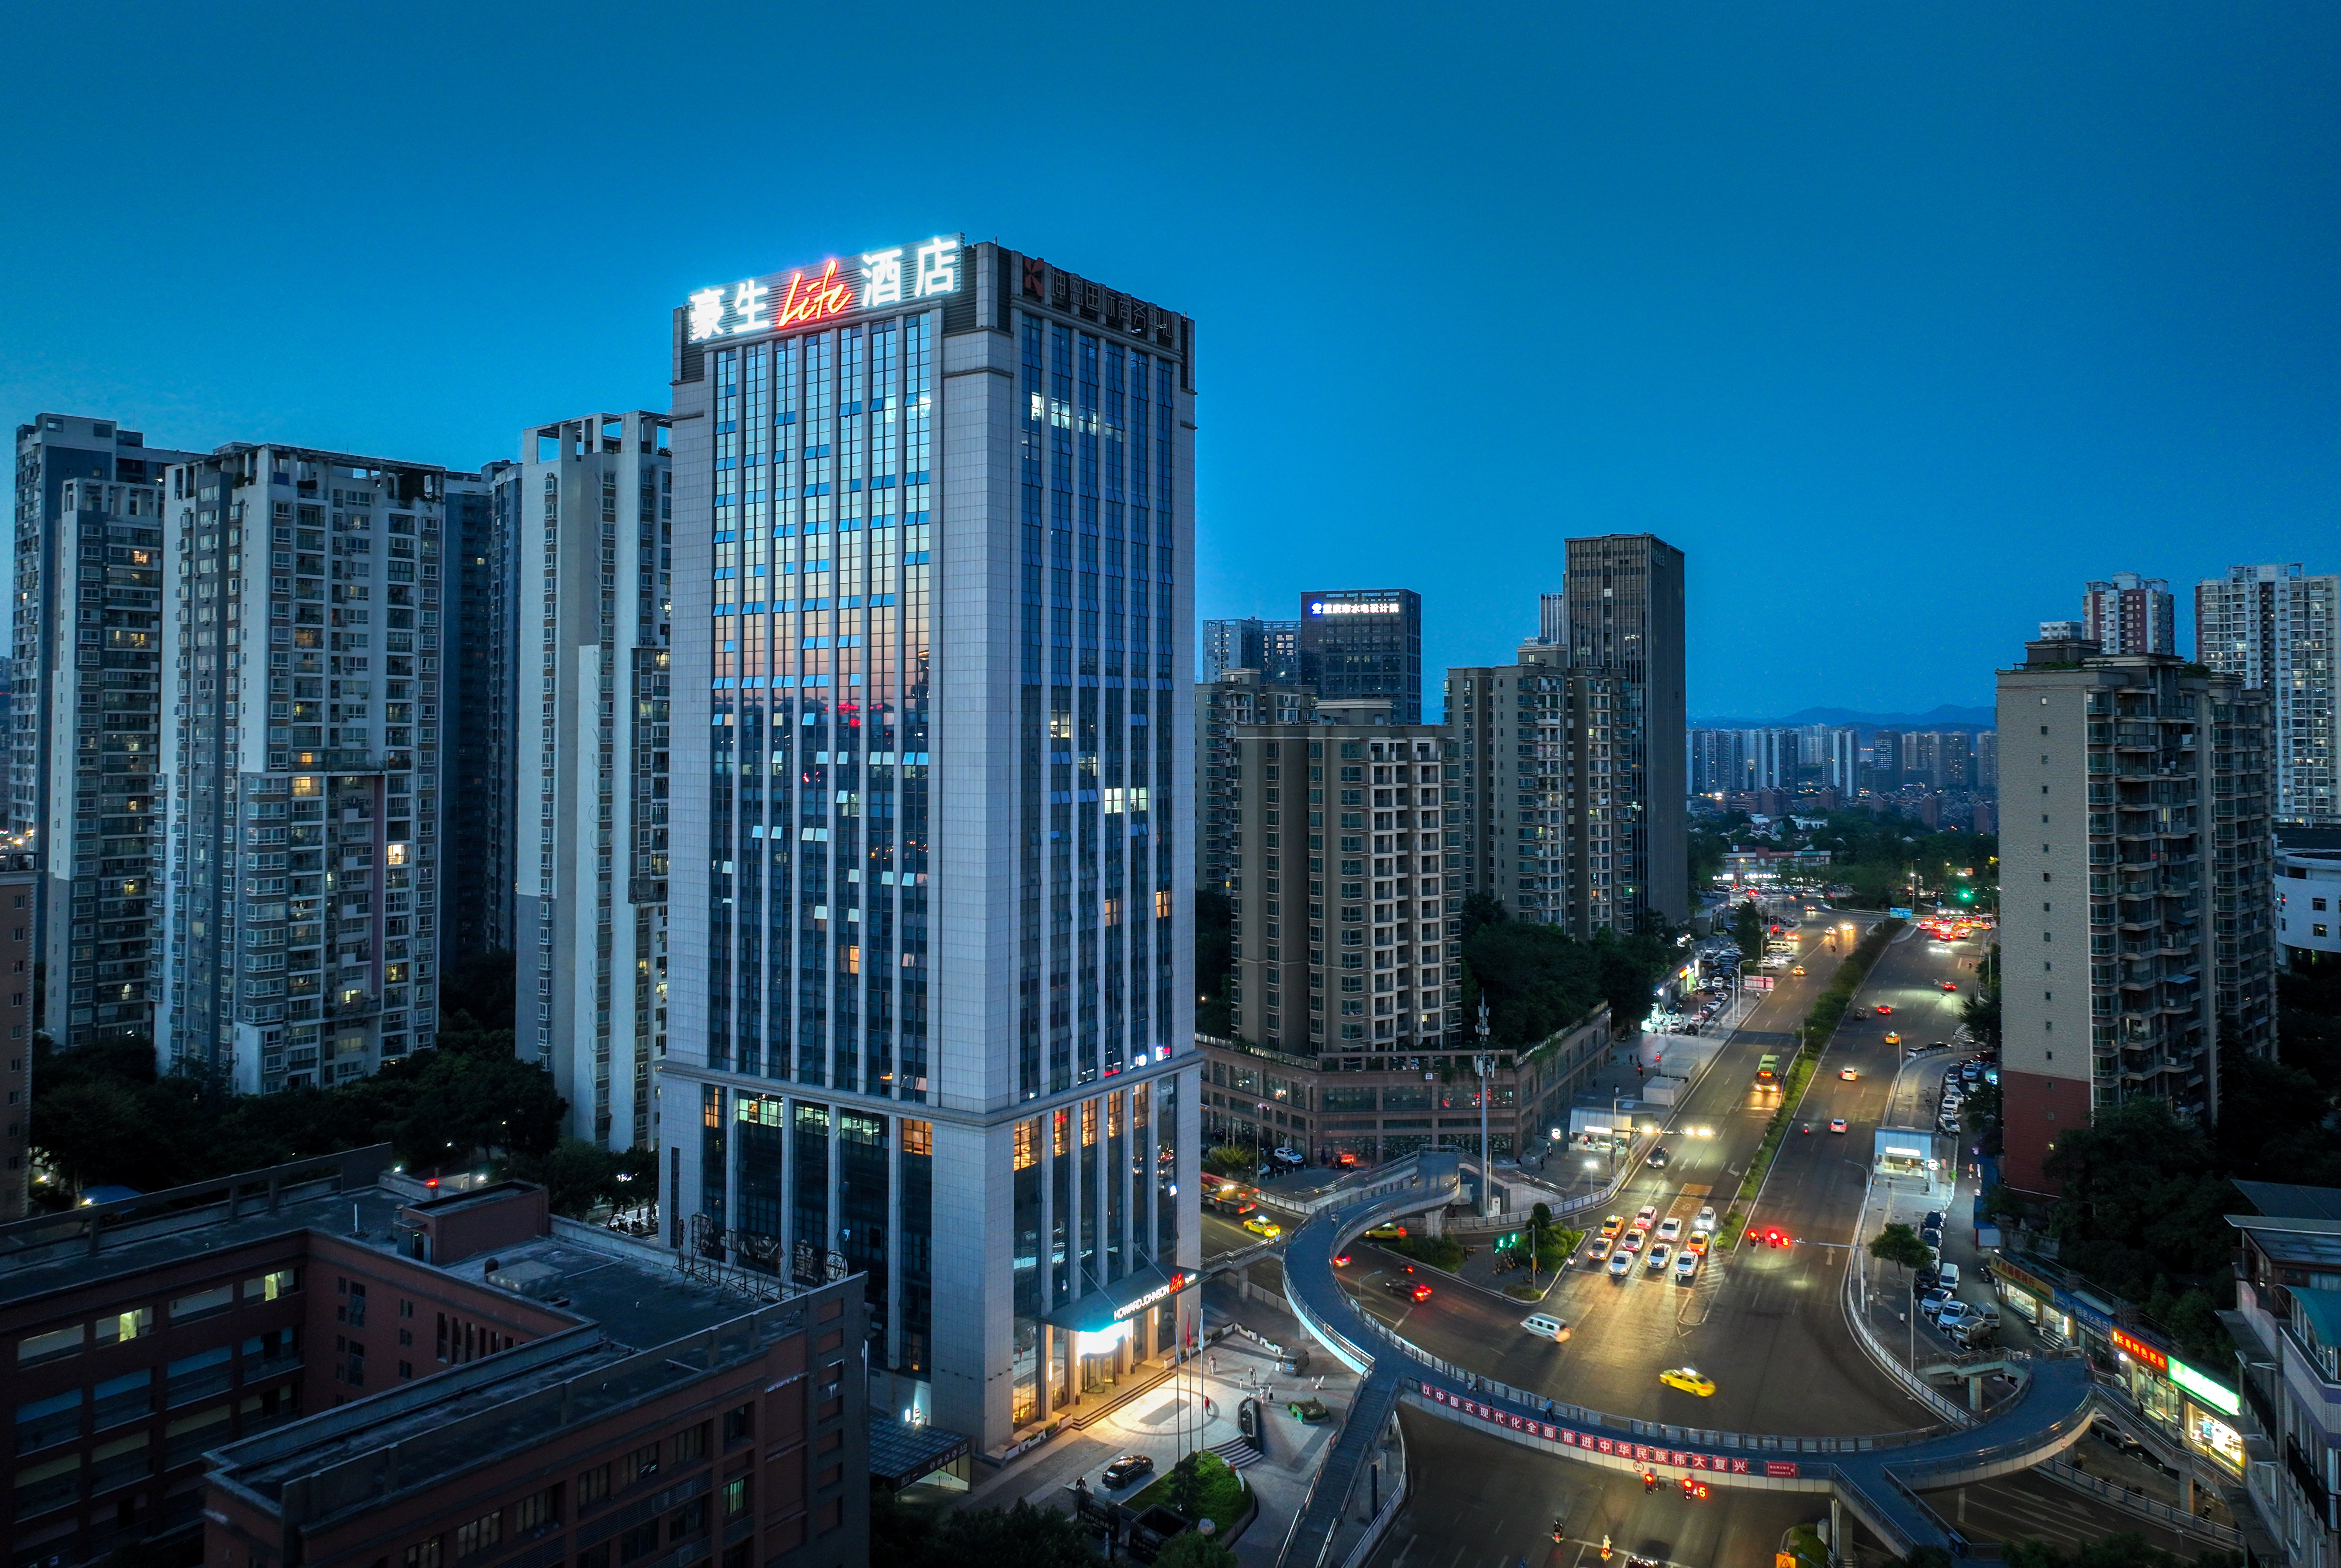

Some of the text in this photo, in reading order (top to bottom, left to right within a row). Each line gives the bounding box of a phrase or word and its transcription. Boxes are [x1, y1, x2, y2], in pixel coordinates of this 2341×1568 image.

[690, 238, 957, 341] 豪生 Life 酒店
[1051, 267, 1174, 338] 坤恩国际商务中心
[1114, 1298, 1142, 1321] HOWARD
[1142, 1285, 1170, 1307] JOHNSON
[1170, 1273, 1184, 1293] Life
[1423, 1384, 1745, 1472] 以中国式现代化全面推进中华民族伟大复兴
